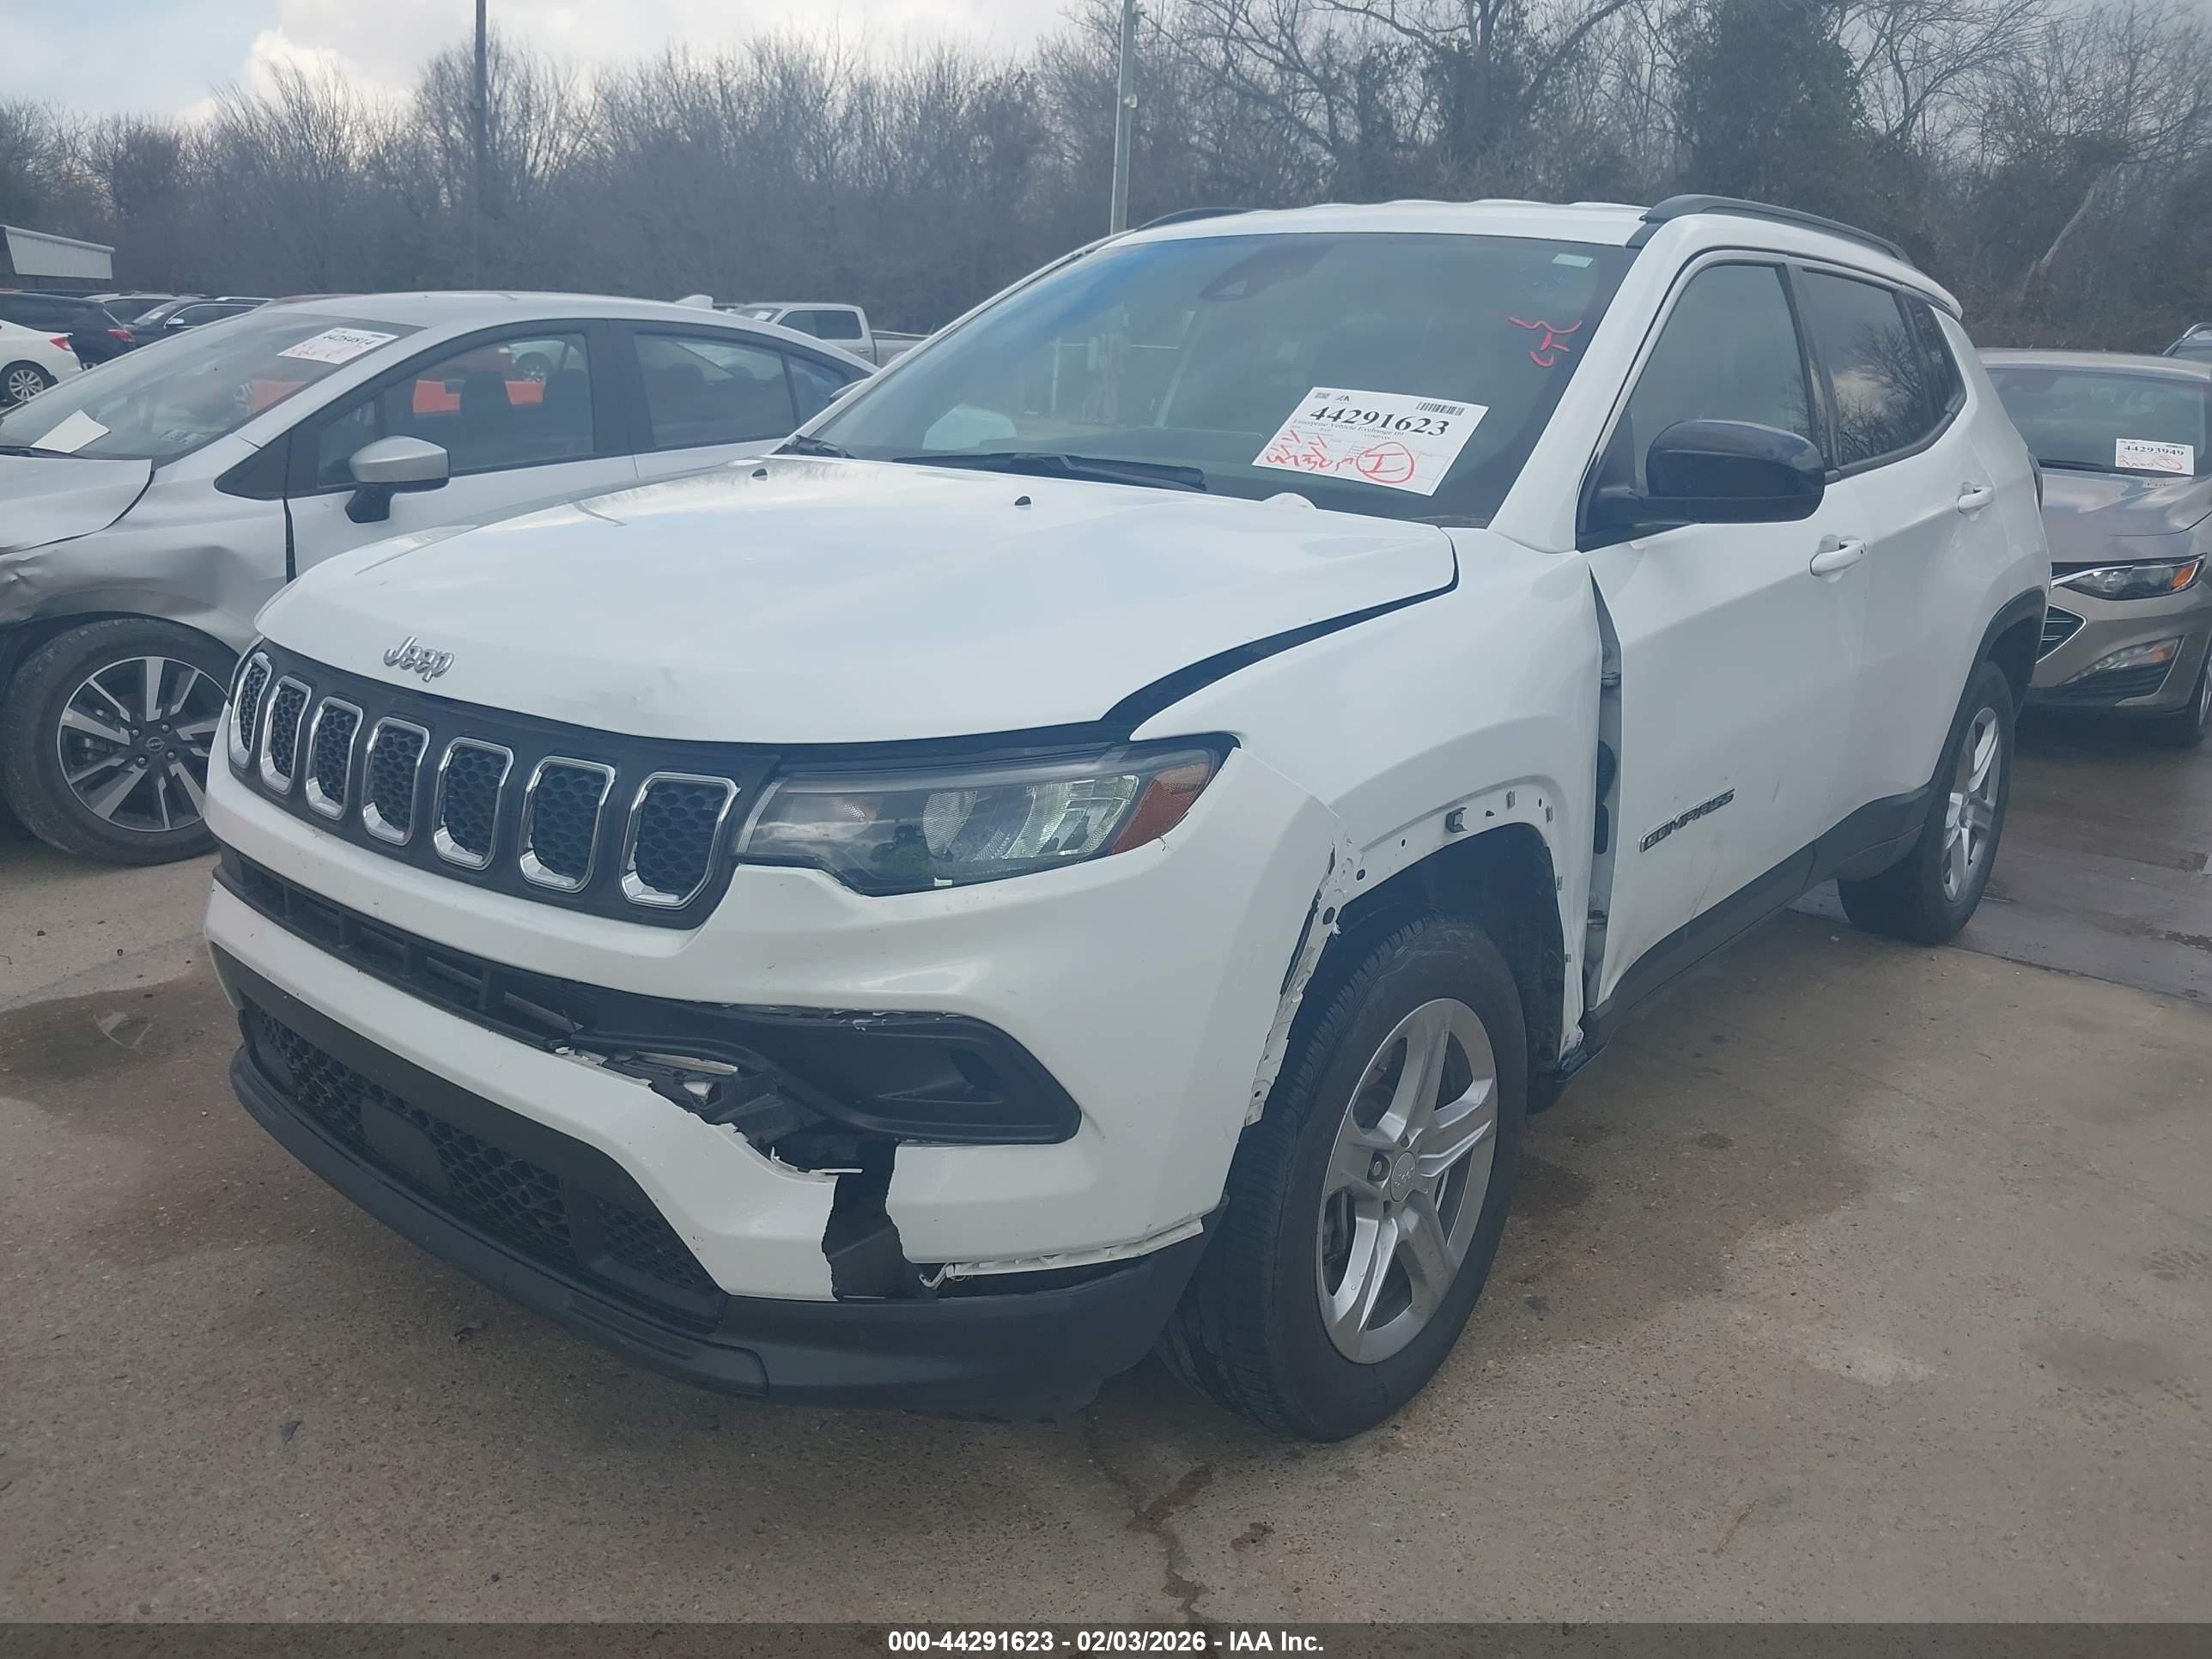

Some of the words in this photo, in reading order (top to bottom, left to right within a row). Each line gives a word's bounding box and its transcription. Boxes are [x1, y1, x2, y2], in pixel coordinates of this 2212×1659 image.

[1310, 405, 1450, 437] 44291623
[383, 635, 454, 684] Jeep
[1639, 787, 1735, 853] COMPASS
